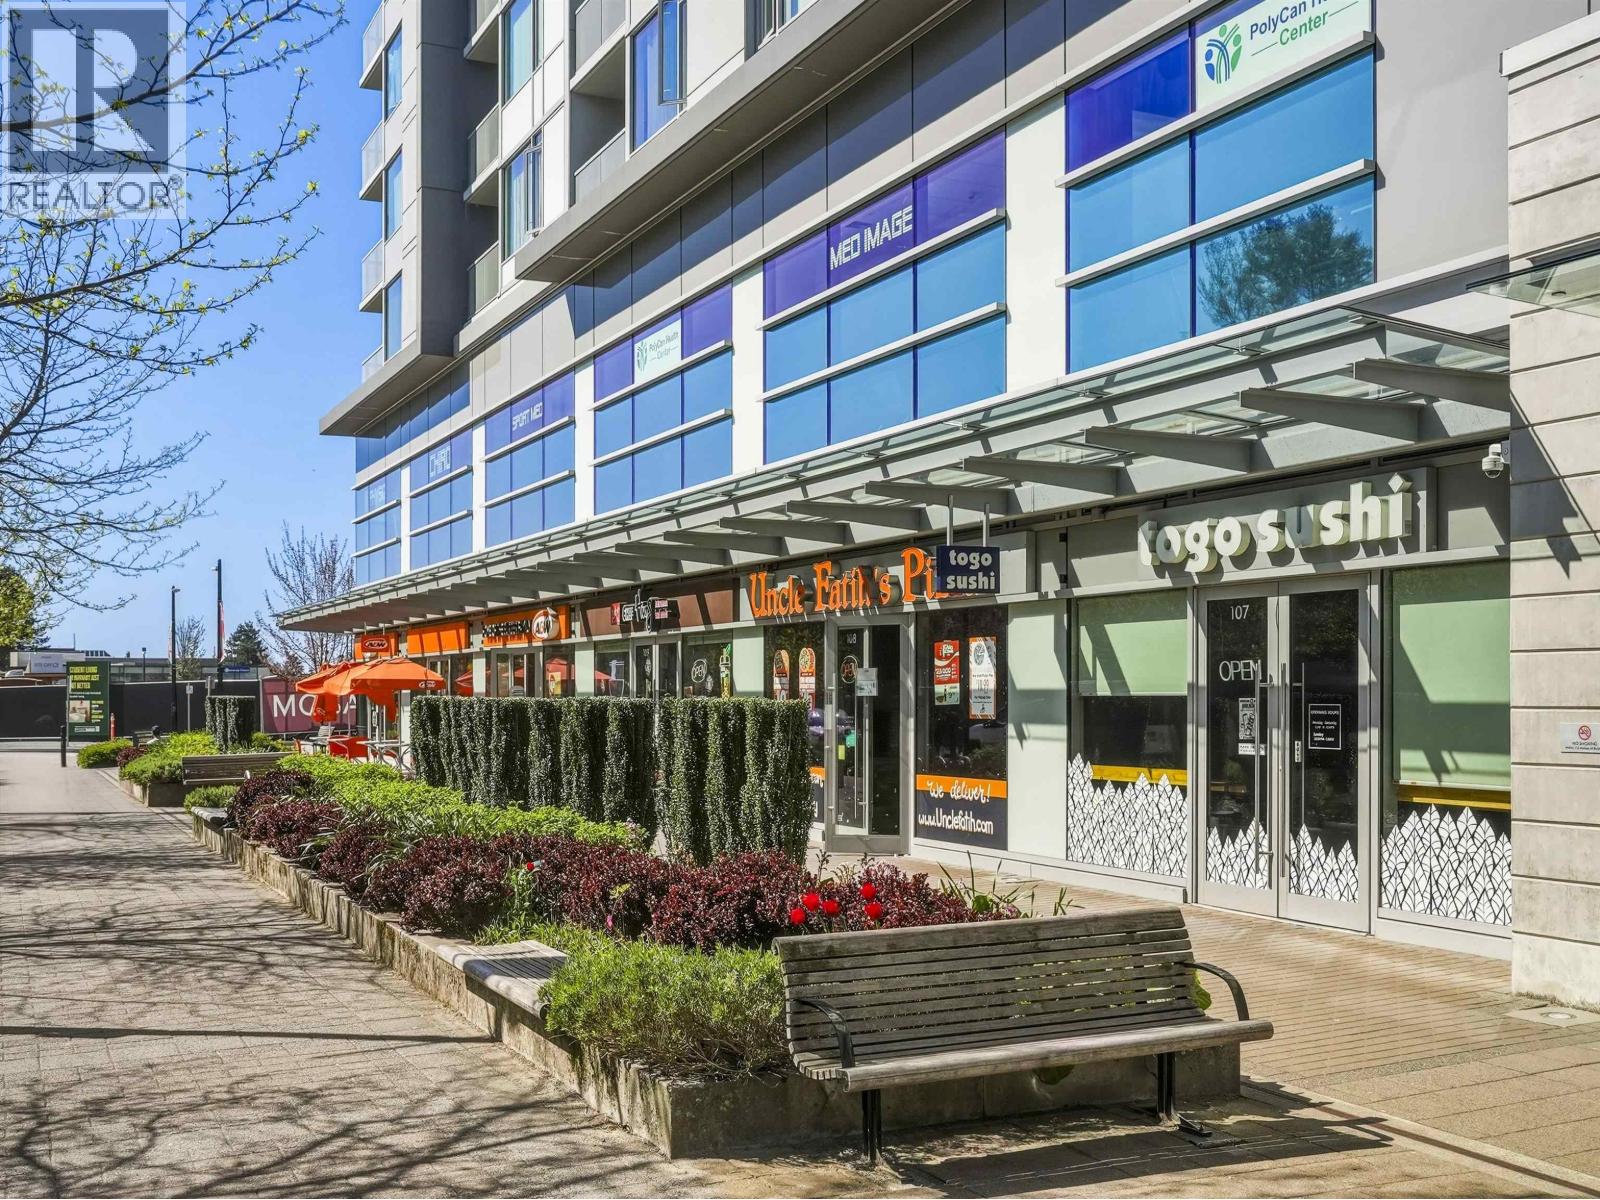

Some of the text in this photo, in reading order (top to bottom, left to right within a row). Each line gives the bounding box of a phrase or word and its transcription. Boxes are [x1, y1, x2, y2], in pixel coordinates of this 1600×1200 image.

[1250, 1, 1307, 40] PolyCan
[1279, 11, 1329, 46] Center
[830, 204, 913, 271] MED IMAGE
[1138, 473, 1412, 573] togo sushi
[949, 549, 993, 570] togo
[946, 570, 996, 590] sushi
[749, 572, 804, 618] Uncle
[1230, 604, 1250, 620] 107
[1219, 659, 1262, 682] OPEN
[950, 780, 991, 804] deliver!
